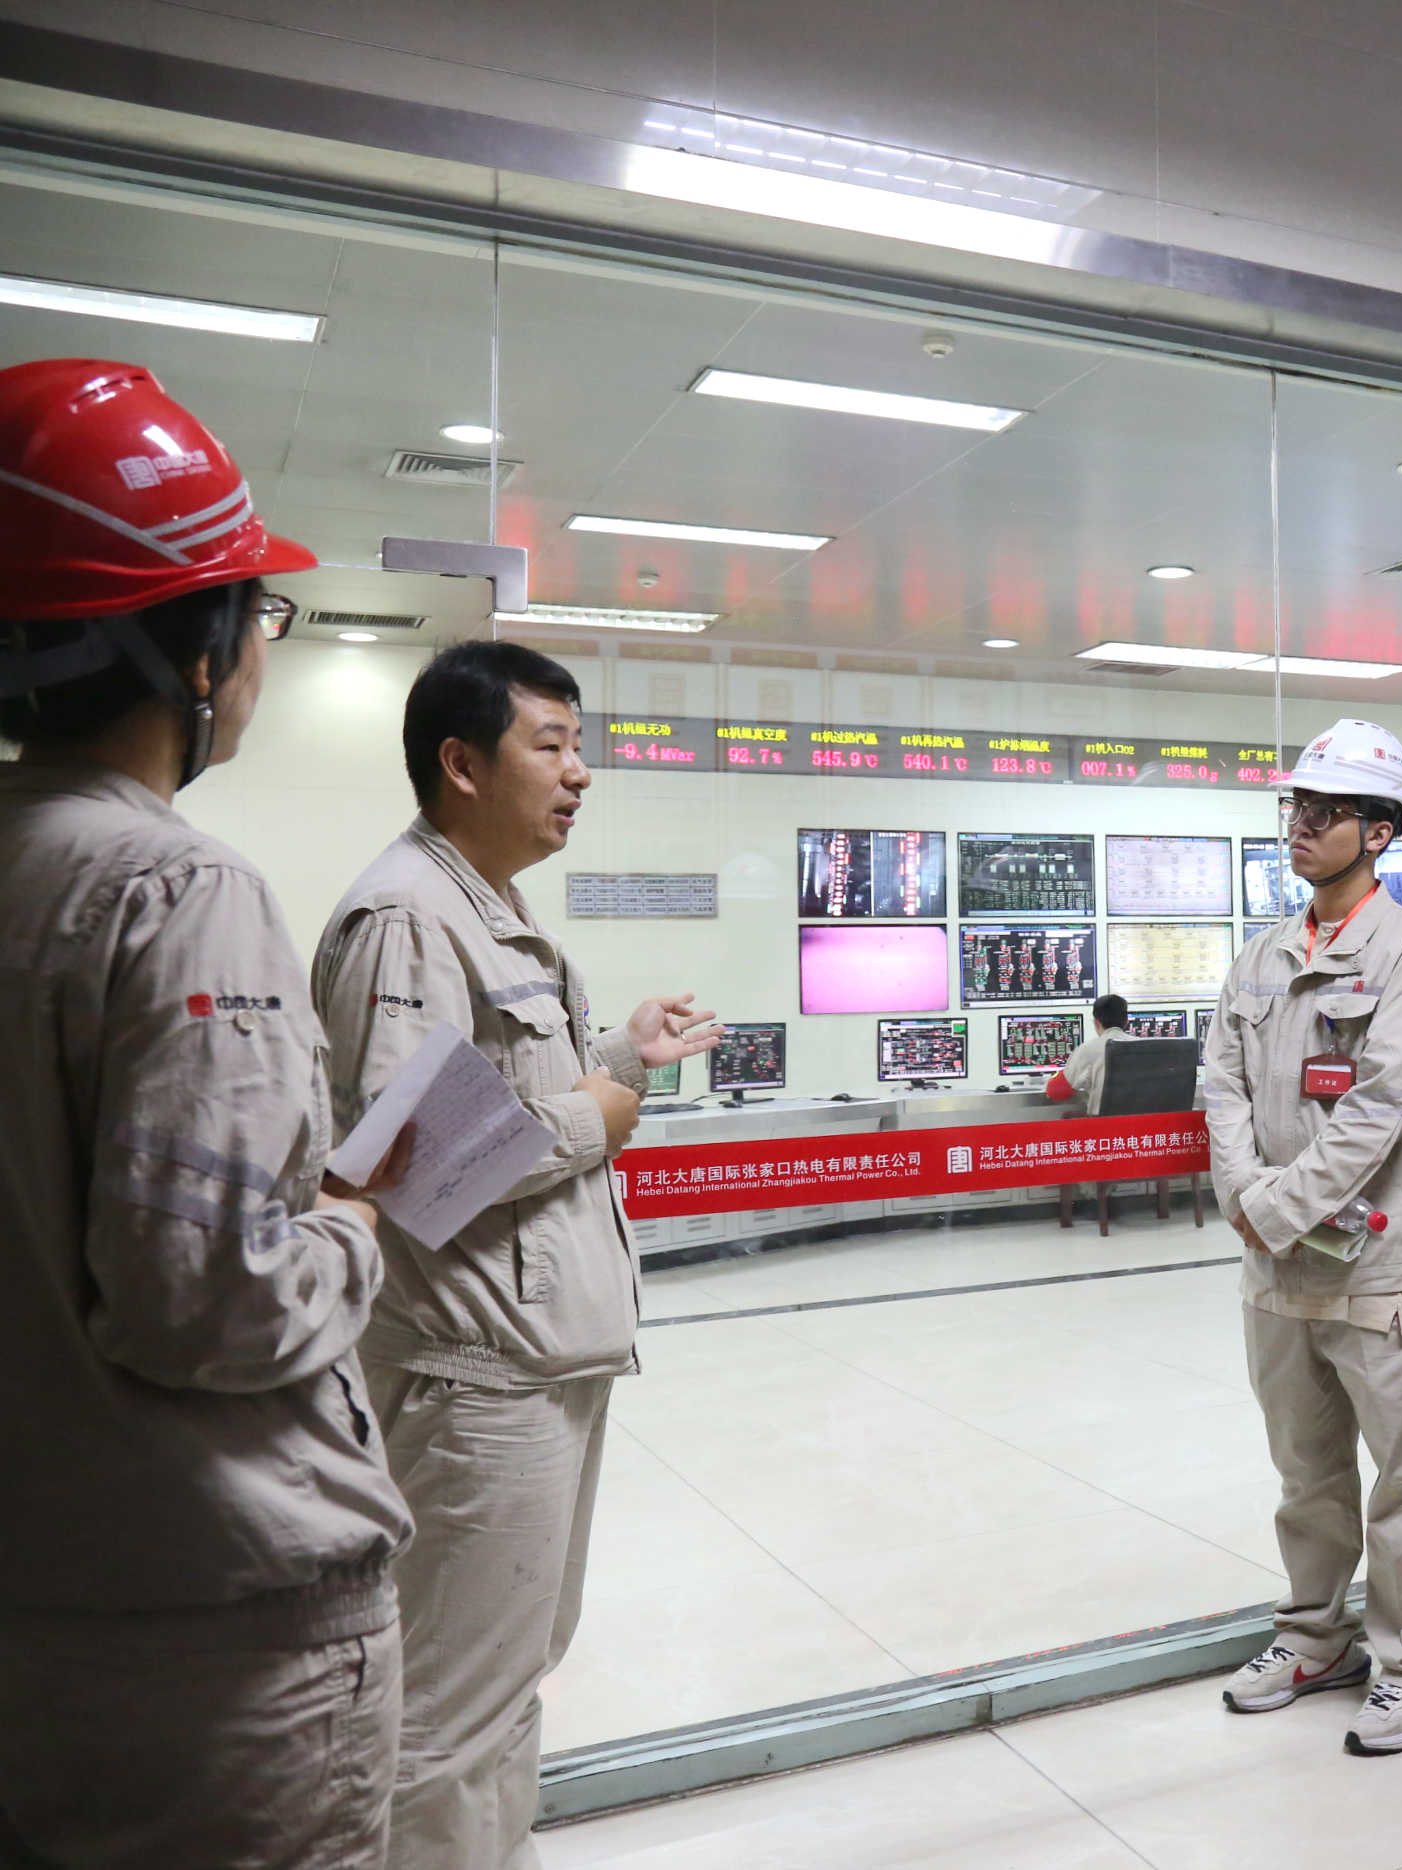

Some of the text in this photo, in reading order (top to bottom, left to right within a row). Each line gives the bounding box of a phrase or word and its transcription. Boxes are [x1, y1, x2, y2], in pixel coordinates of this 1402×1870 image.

[609, 722, 672, 736] #1机组无功
[716, 727, 788, 742] #1机组真空度
[810, 731, 879, 745] #1机过热汽温
[900, 735, 966, 749] #1机再热汽温
[216, 995, 281, 1010] 中国大唐
[379, 994, 424, 1009] 中国大唐
[1318, 1078, 1338, 1087] 工作证
[979, 1130, 1209, 1161] 河北大唐国际张家口热电有限责任公
[979, 1161, 1004, 1170] Hebei
[1005, 1158, 1034, 1169] Datang
[1035, 1154, 1085, 1166] International
[1086, 1151, 1133, 1162] Zhangjiakou
[1134, 1147, 1165, 1158] Thermal
[1165, 1147, 1190, 1156] Power
[636, 1151, 922, 1188] 河北大唐国际张家口热电有限责任公司
[636, 1167, 922, 1198] Hebei Datang International Zhangjiakou Thermal Power Co., Ltd.
